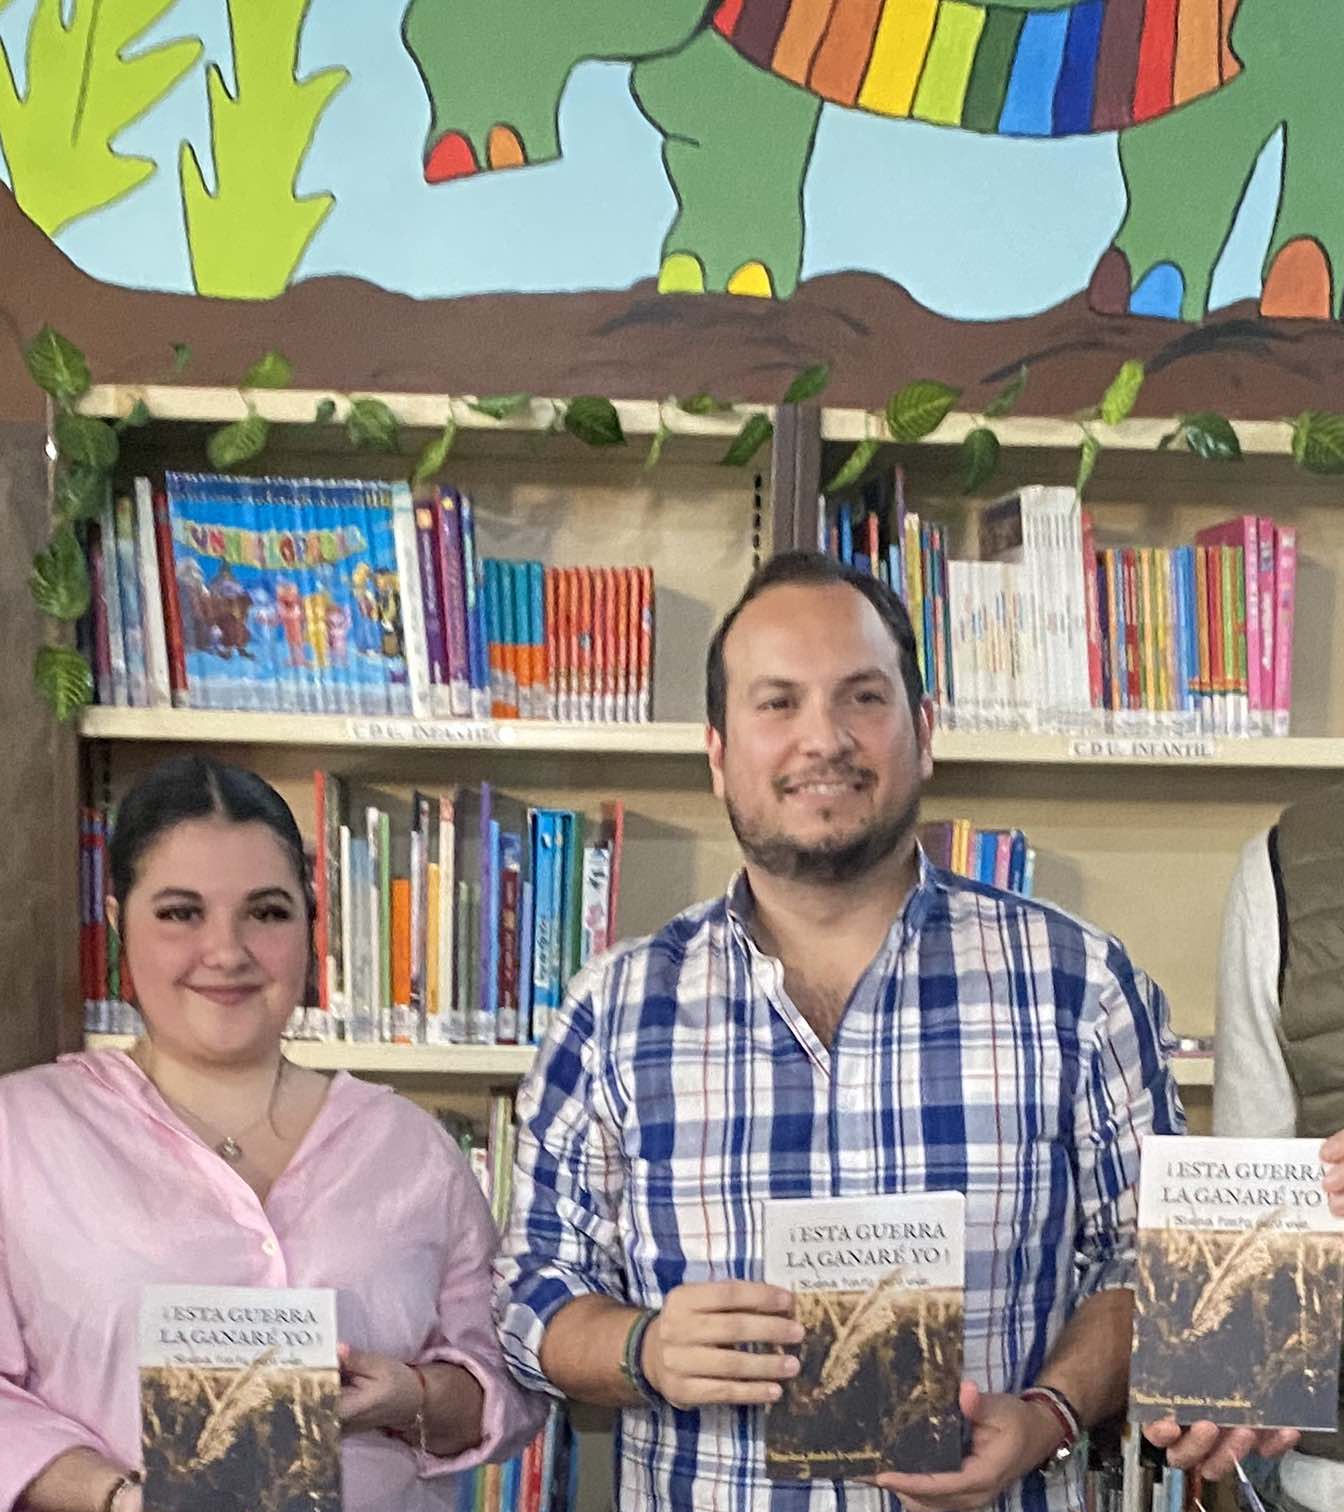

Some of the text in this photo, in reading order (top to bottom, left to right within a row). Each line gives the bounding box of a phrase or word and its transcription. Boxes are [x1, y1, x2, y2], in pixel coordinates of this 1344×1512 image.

[1131, 743, 1211, 757] INFANTIL
[1235, 1162, 1327, 1181] GUERRA
[1161, 1186, 1324, 1207] LA GANARÉ YO
[855, 1222, 948, 1240] GUERRA
[785, 1252, 816, 1268] LA
[817, 1244, 907, 1267] GANARÉ
[227, 1307, 319, 1324] GUERRA
[159, 1329, 188, 1344] LA
[190, 1327, 279, 1346] GANARÉ
